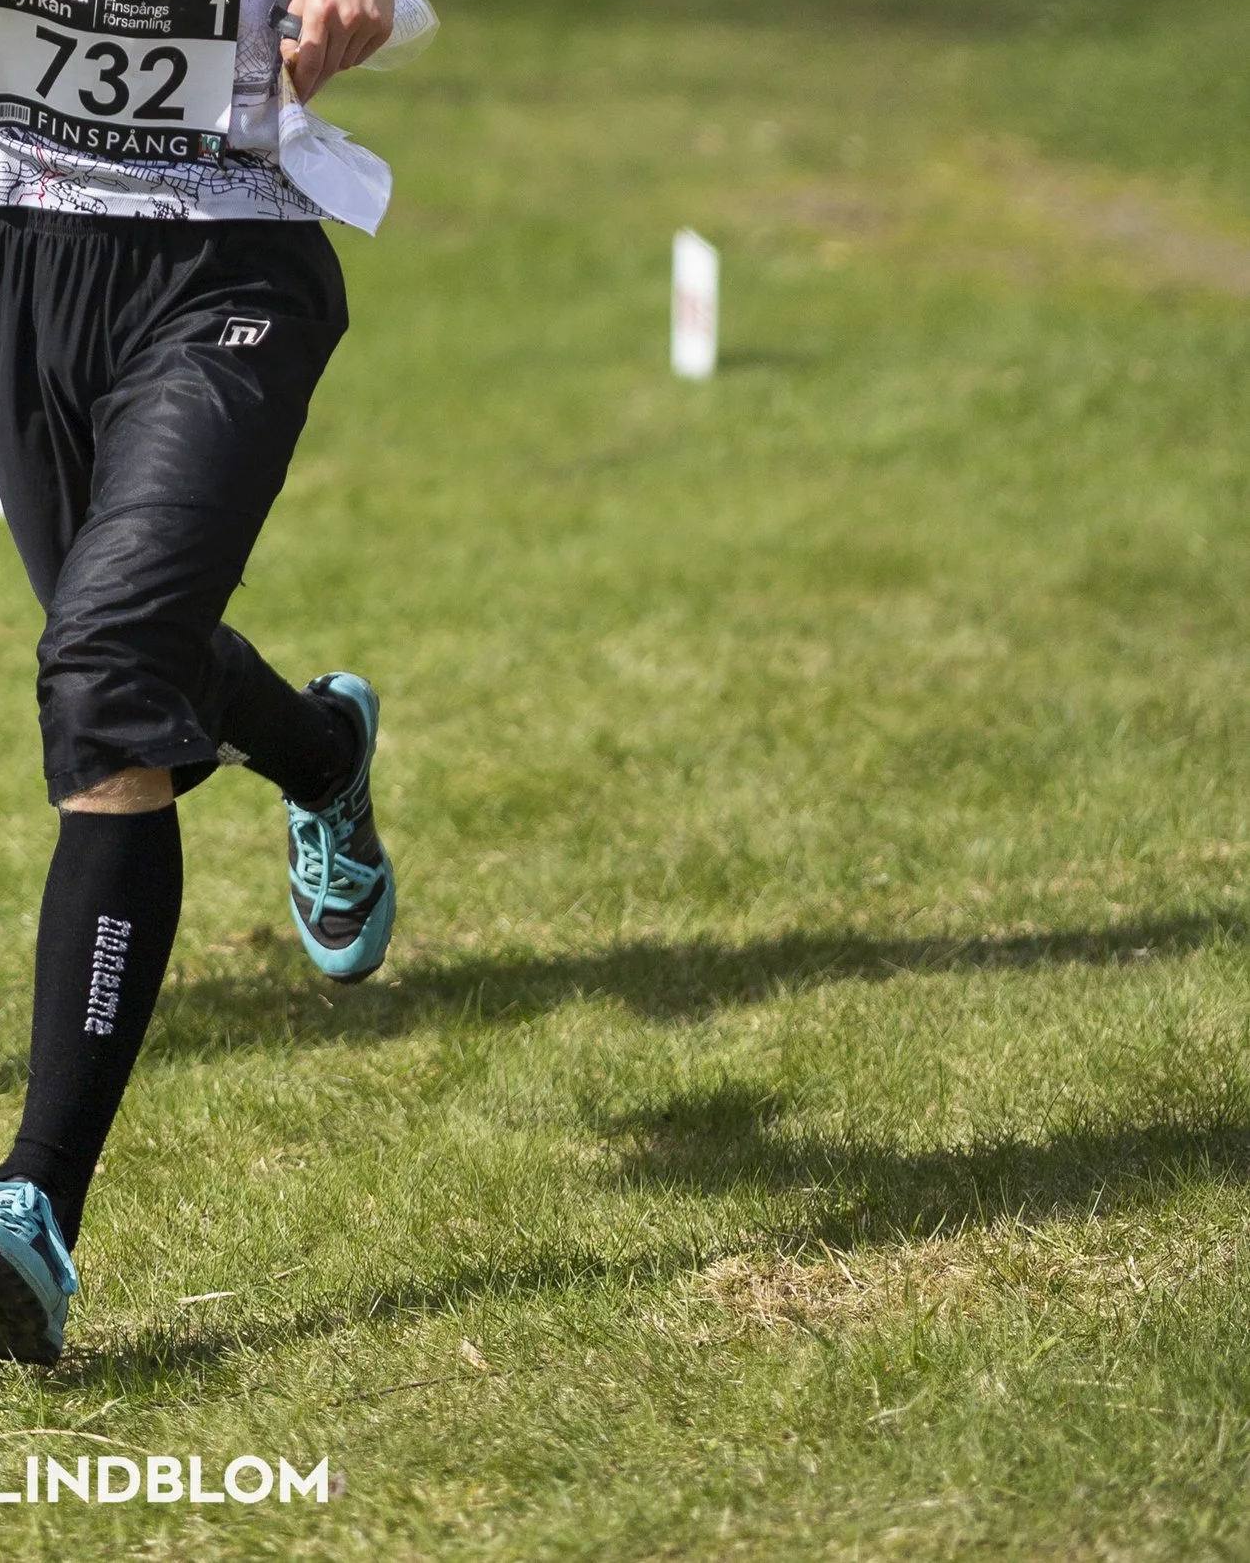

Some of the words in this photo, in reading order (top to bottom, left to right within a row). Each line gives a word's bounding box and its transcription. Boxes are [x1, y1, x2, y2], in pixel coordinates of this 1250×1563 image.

[103, 13, 171, 33] församling
[104, 0, 169, 18] Finspångs
[35, 24, 188, 121] 732
[37, 111, 188, 156] FINSPÅNG
[85, 915, 132, 1035] noname
